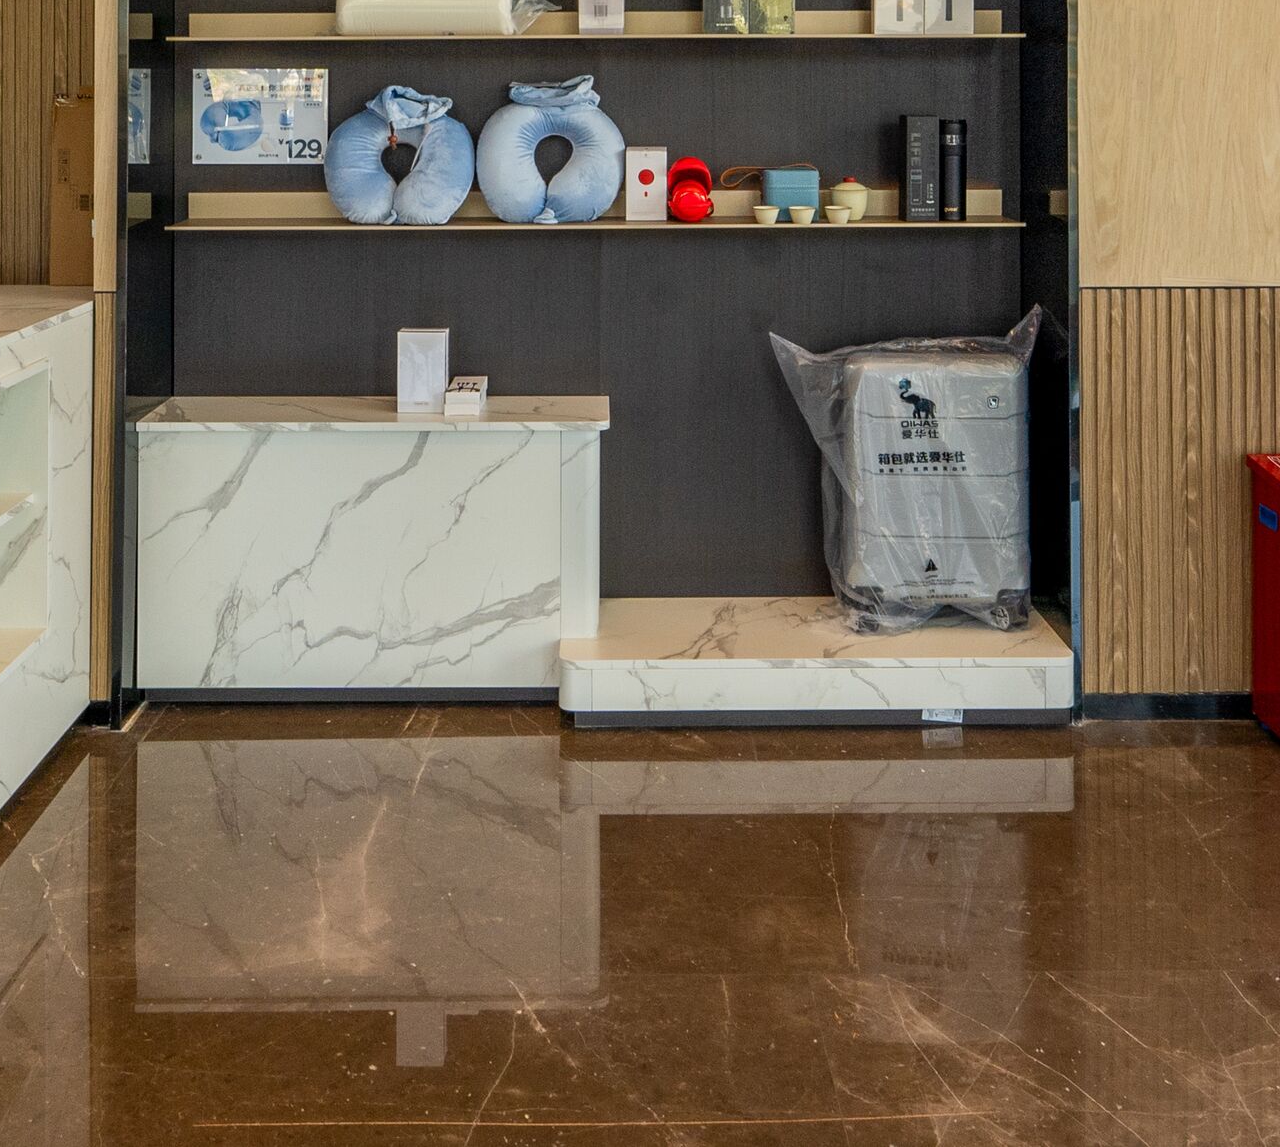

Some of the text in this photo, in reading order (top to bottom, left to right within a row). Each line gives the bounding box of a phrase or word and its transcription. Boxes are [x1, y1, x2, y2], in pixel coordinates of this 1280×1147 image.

[278, 138, 321, 159] ¥129
[901, 420, 939, 428] OIWAS
[902, 429, 940, 439] 爱华仕
[878, 451, 966, 465] 箱包就选爱华仕
